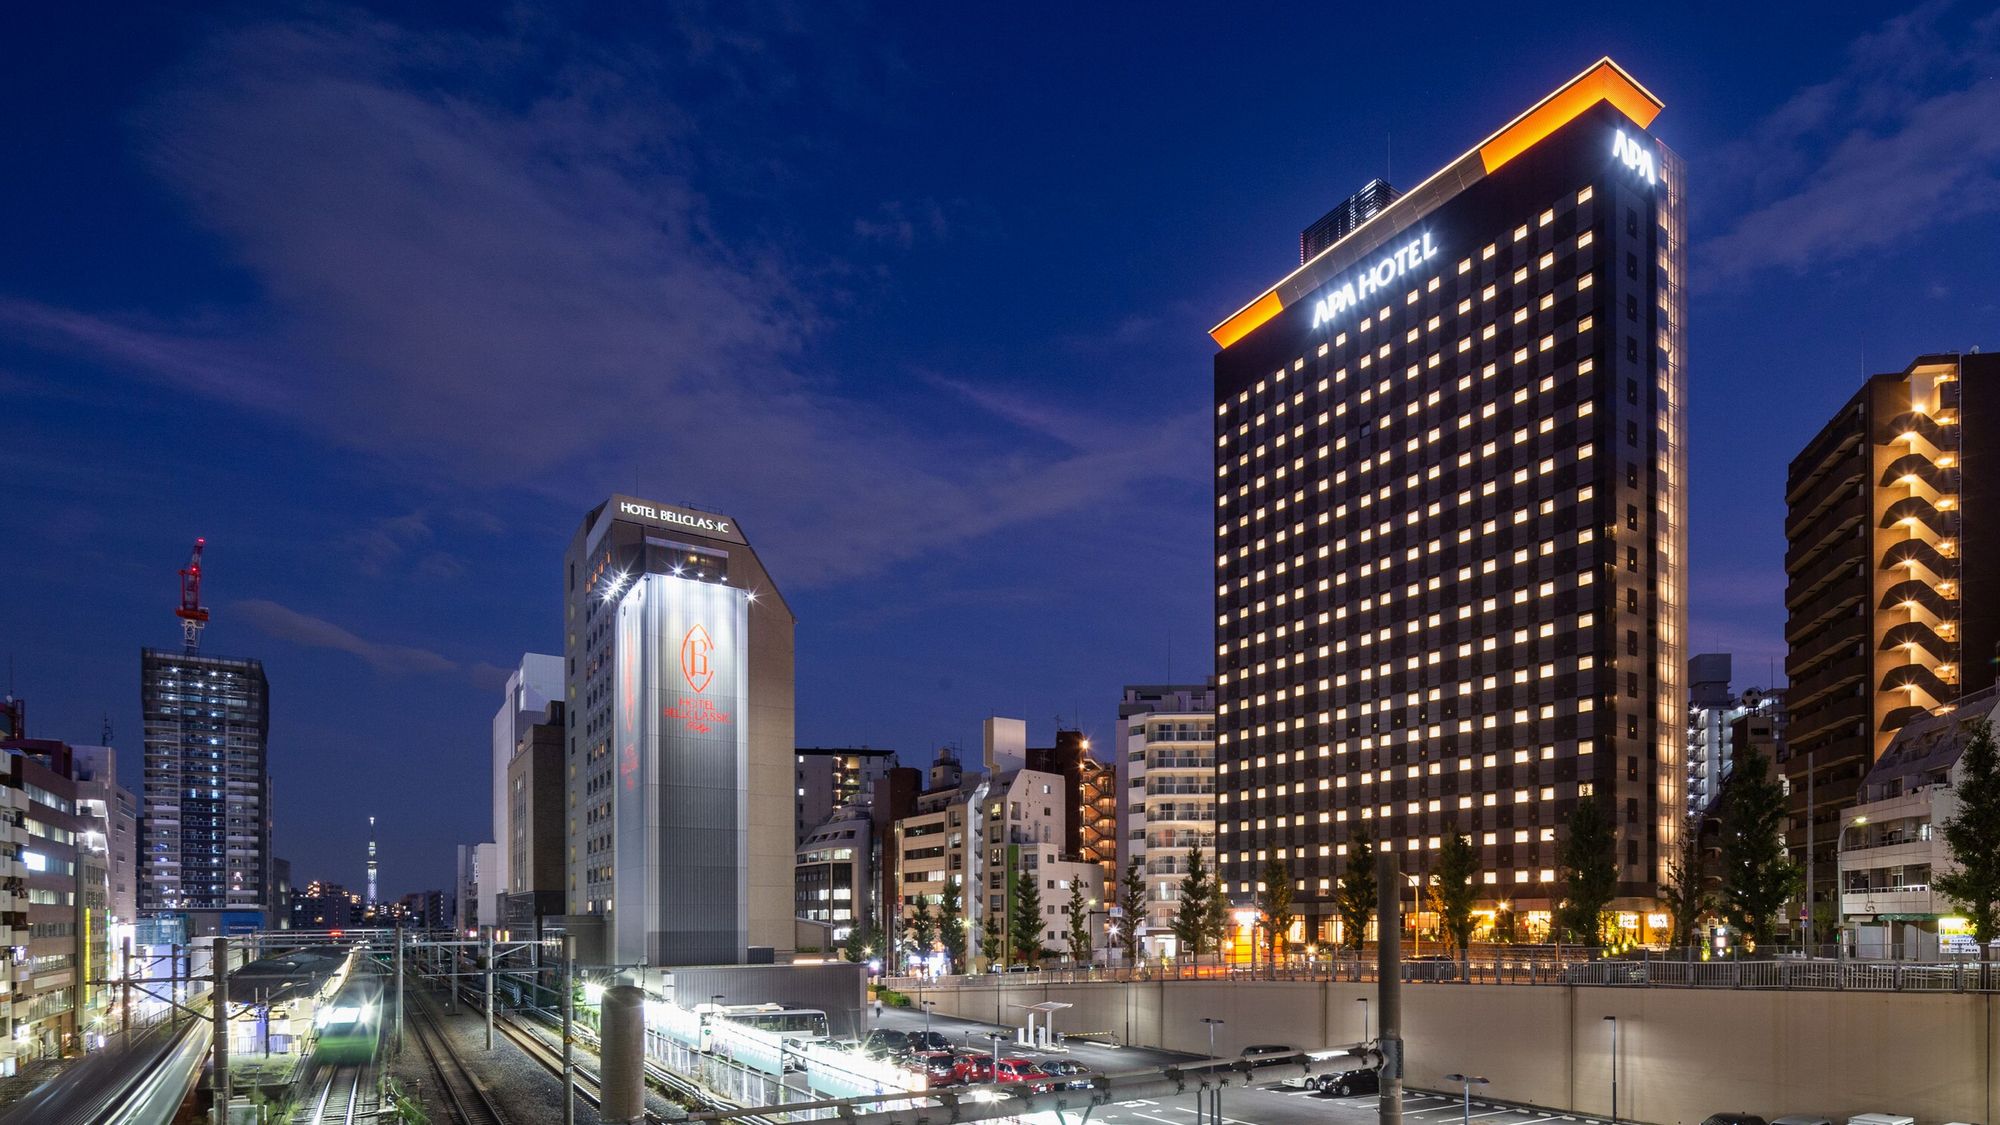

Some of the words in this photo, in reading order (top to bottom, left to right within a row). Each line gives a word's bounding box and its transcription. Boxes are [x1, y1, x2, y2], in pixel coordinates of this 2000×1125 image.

[1612, 129, 1656, 185] APA
[1313, 283, 1357, 329] APA
[1359, 232, 1438, 300] HOTEL
[620, 502, 658, 519] HOTEL
[660, 510, 729, 533] BELLCLASSIC
[678, 697, 715, 711] HOTEL
